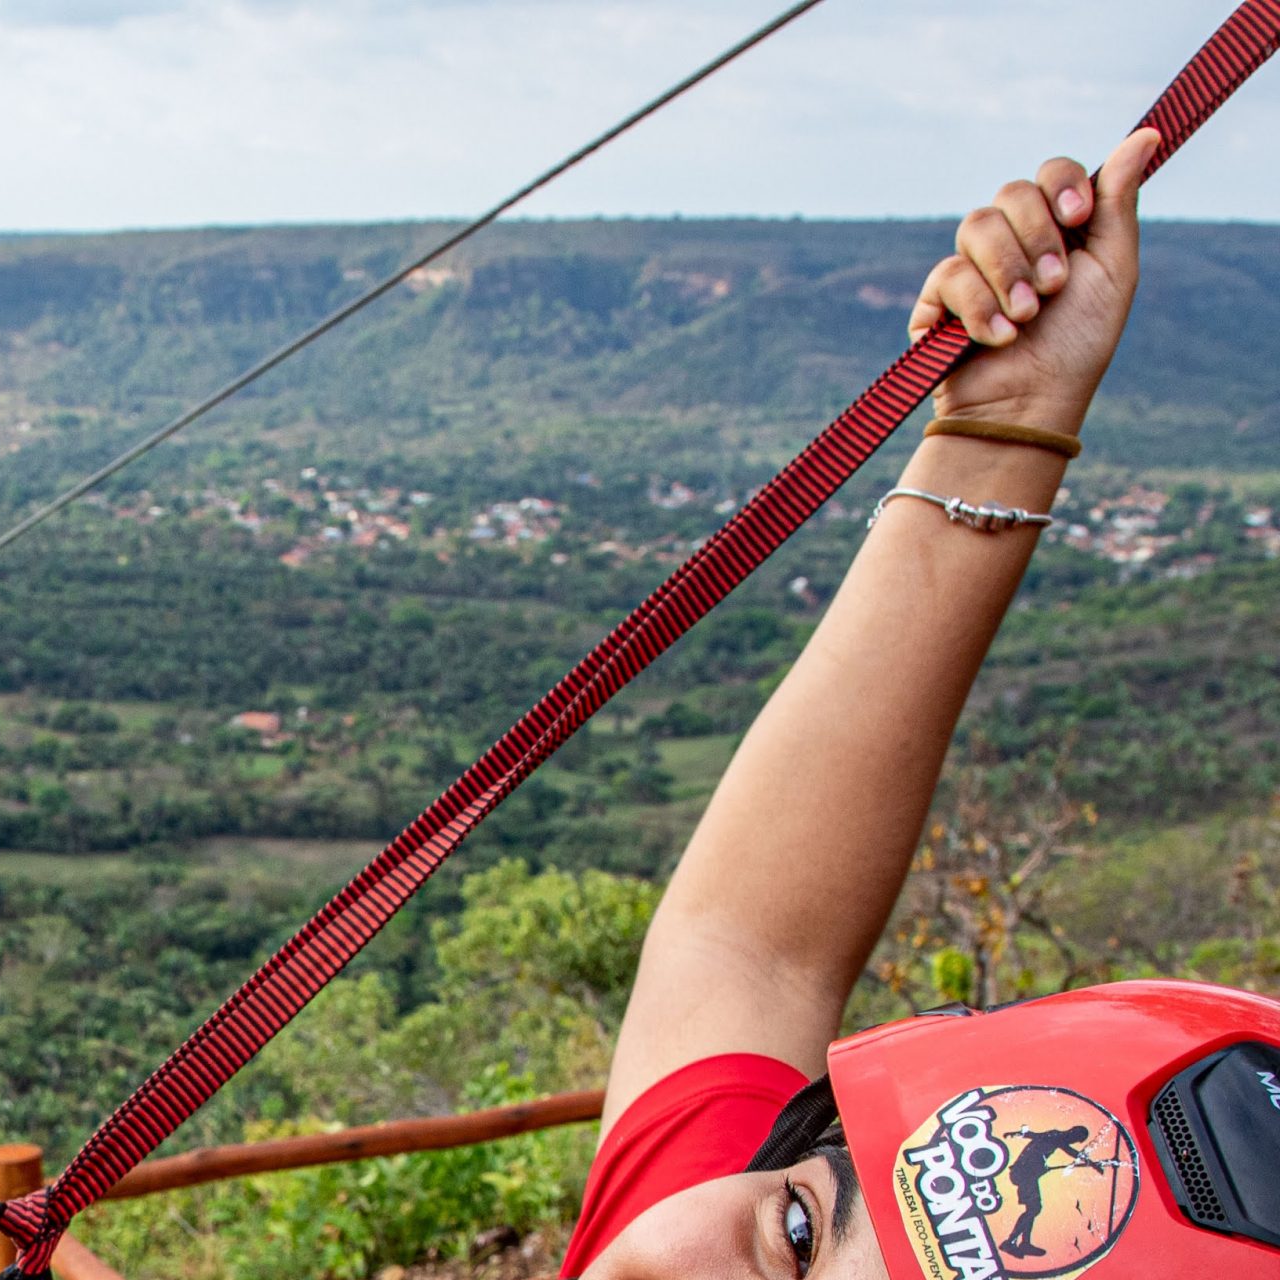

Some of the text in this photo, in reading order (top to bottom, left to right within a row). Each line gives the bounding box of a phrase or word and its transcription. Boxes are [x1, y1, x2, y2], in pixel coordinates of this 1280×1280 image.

[940, 1090, 1005, 1177] VOO
[895, 1166, 919, 1213] TIROLESA
[970, 1179, 998, 1211] DO
